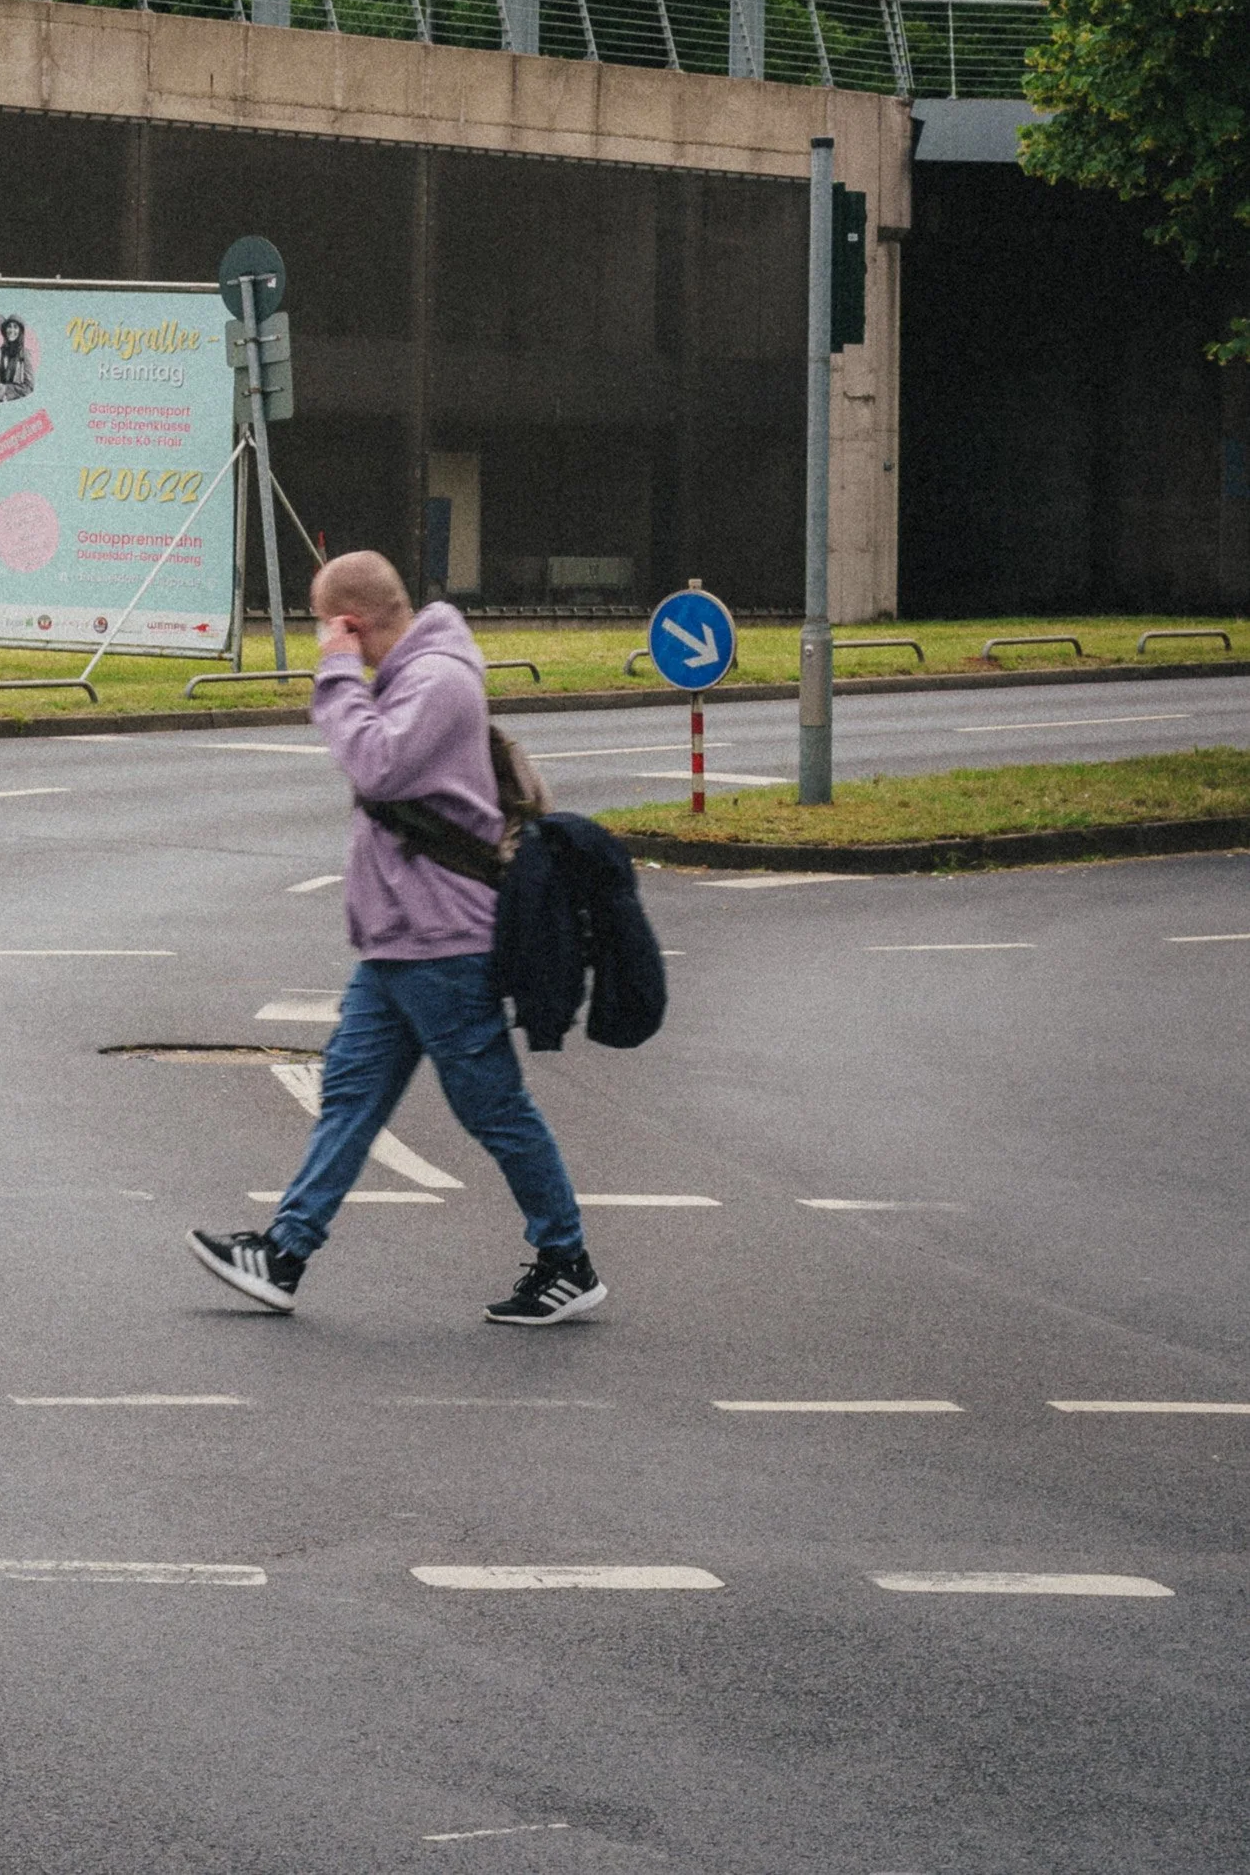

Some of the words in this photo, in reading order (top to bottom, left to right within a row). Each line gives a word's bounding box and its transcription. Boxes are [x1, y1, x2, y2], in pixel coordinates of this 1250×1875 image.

[100, 363, 185, 388] Renntag
[88, 402, 191, 419] Galopprennsport
[87, 418, 107, 430] der
[110, 419, 191, 433] Spitzenklasse
[94, 435, 133, 446] meets
[78, 466, 203, 504] 12.06.22
